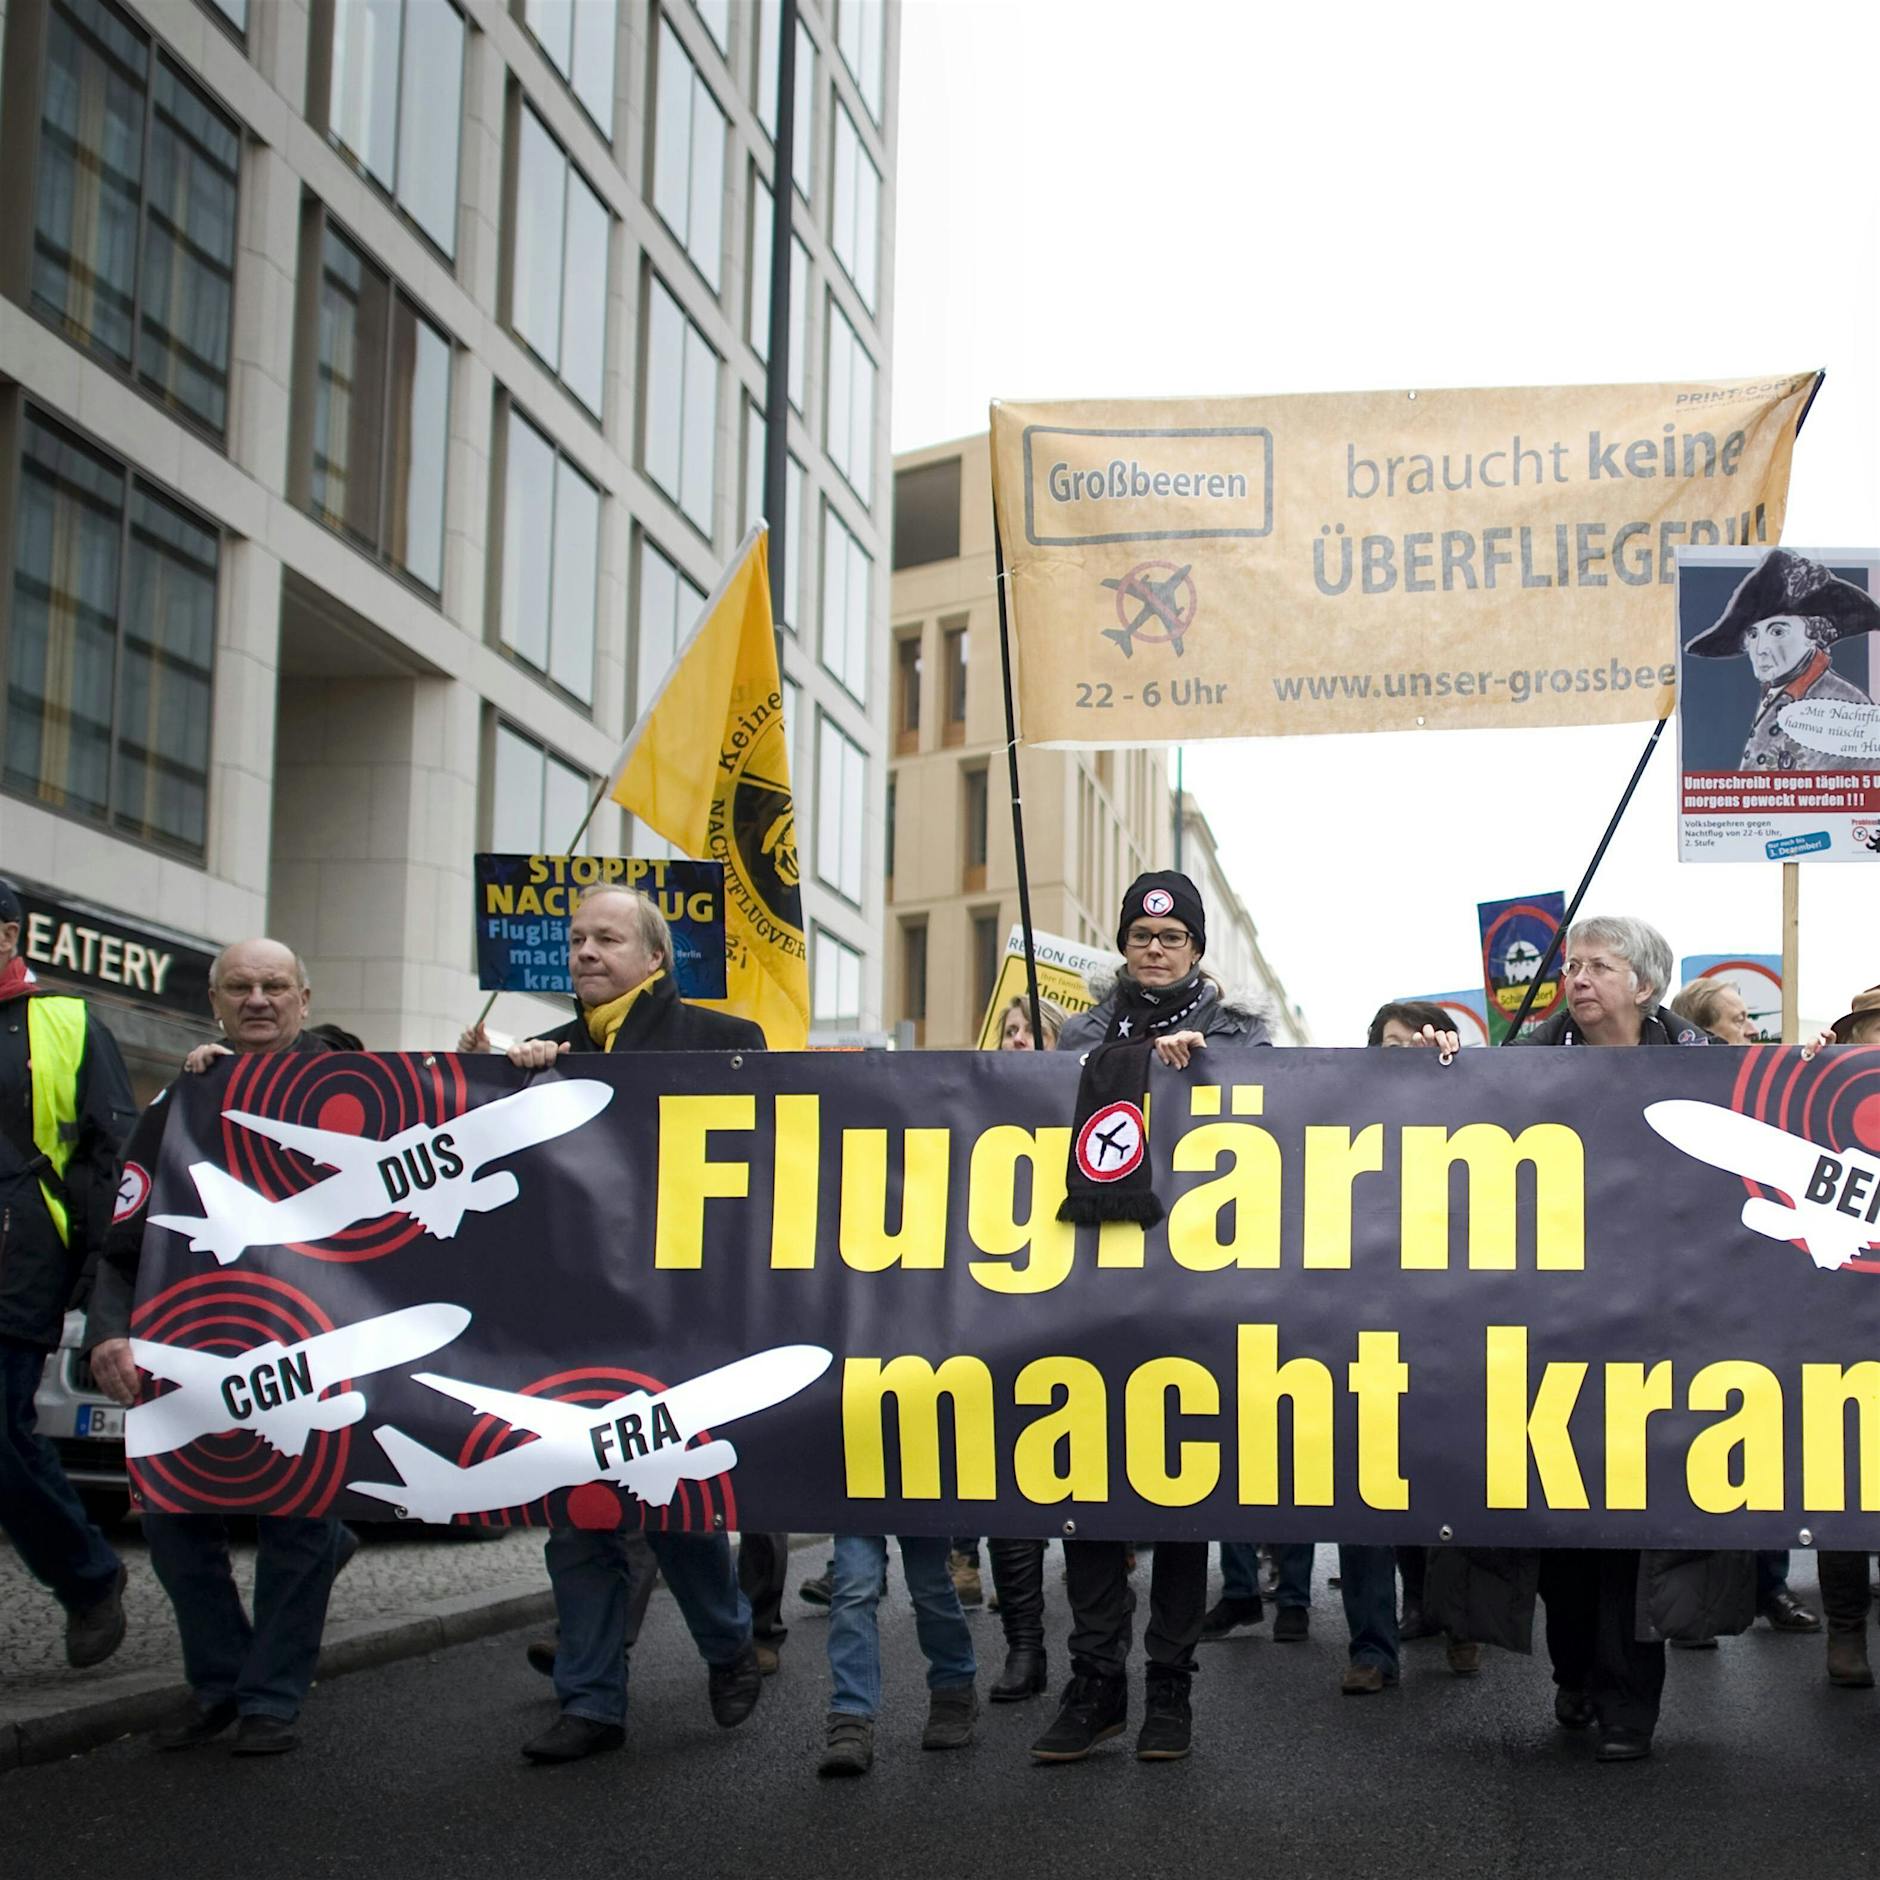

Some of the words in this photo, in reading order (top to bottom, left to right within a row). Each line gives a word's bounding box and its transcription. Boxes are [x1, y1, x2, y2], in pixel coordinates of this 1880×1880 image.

[1049, 460, 1247, 502] Großbeeren
[1347, 435, 1569, 498] braucht
[1588, 424, 1746, 480] keine
[1075, 683, 1114, 708] 22
[1142, 681, 1162, 707] 6
[1170, 677, 1228, 706] Uhr
[719, 692, 783, 774] Keine
[1684, 776, 1771, 790] Unterschreibt
[1774, 779, 1812, 791] gegen
[1816, 776, 1859, 790] täglich
[1862, 776, 1871, 789] 5
[1685, 796, 1740, 808] morgens
[1743, 794, 1795, 808] geweckt
[1799, 794, 1844, 806] werden
[528, 854, 671, 888] STOPPT
[26, 912, 173, 994] EATERY
[377, 1133, 465, 1203] DUS
[221, 1351, 314, 1421] CGN
[842, 1323, 1409, 1510] macht
[590, 1401, 681, 1470] FRA
